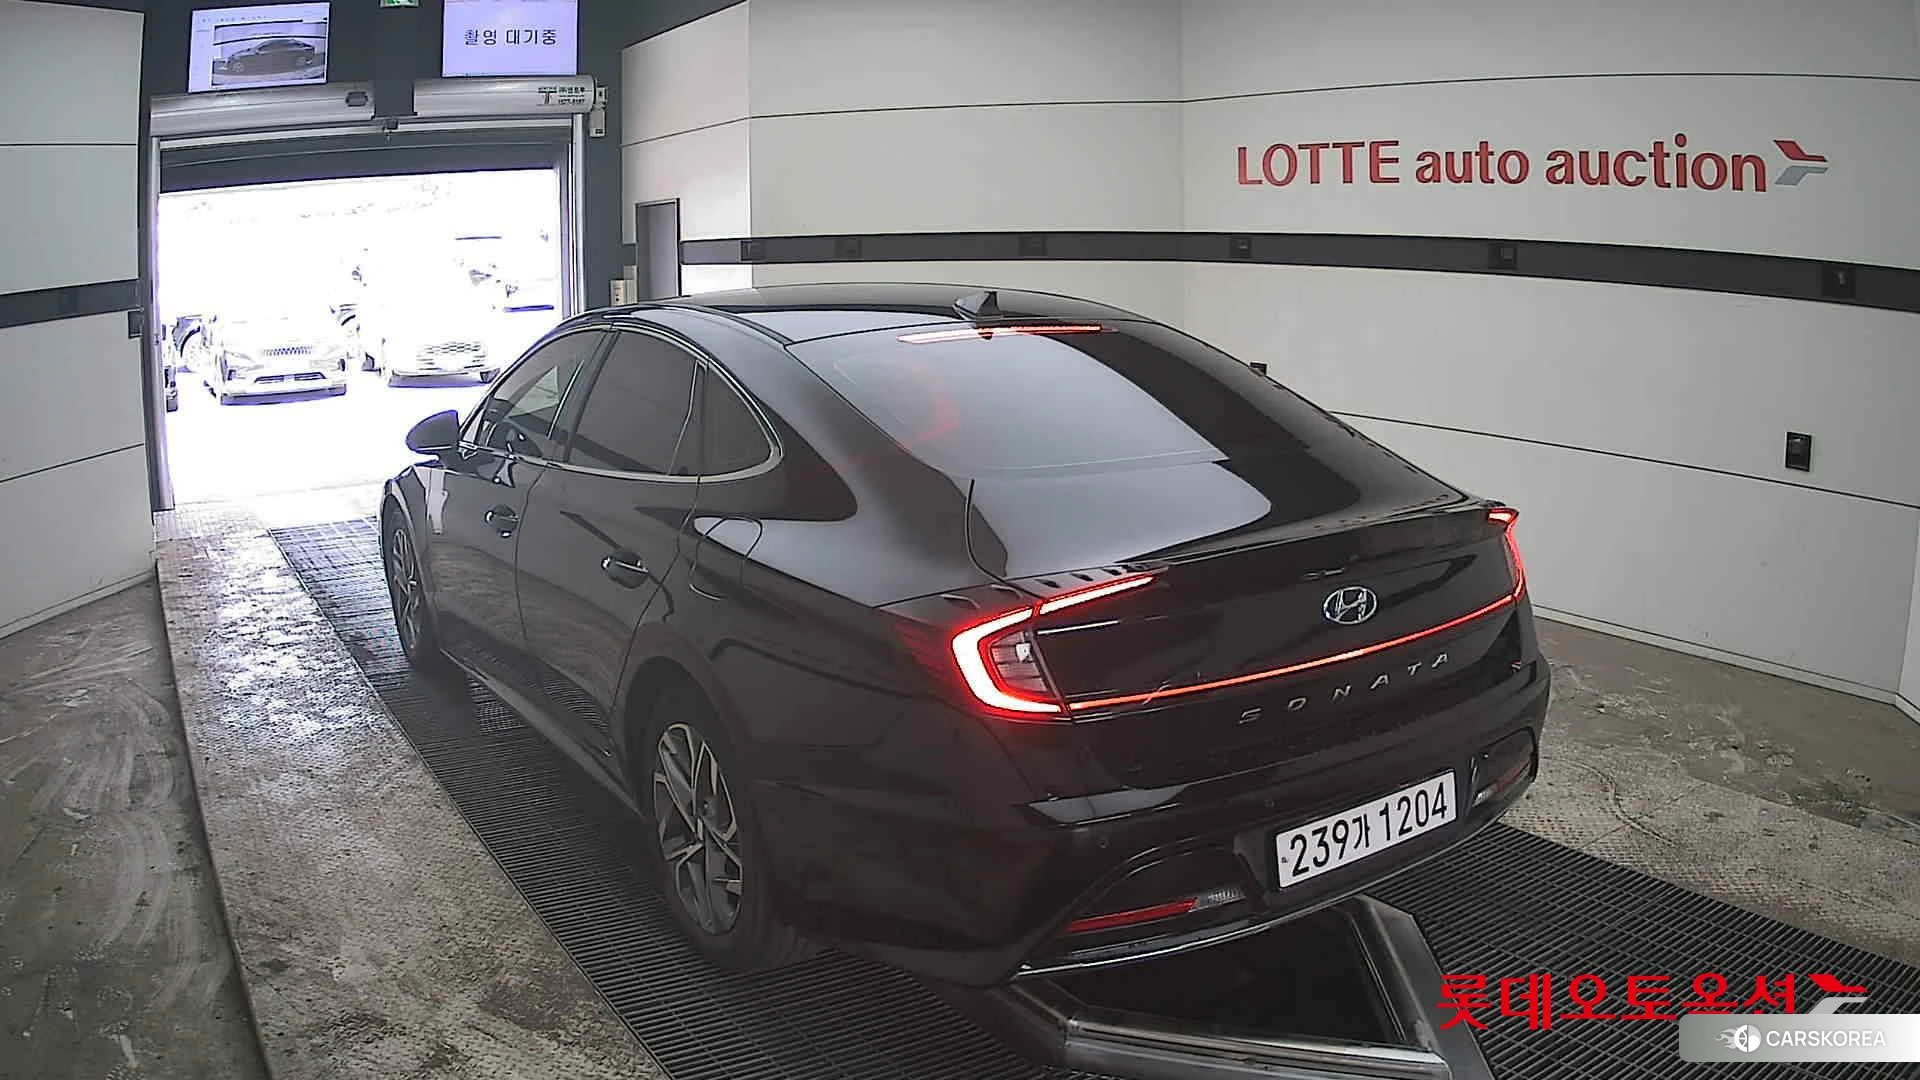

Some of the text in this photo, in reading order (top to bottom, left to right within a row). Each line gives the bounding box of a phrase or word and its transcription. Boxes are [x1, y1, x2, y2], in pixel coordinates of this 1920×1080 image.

[505, 28, 556, 46] 대기중
[1237, 132, 1767, 193] LOTTE auto auction
[1239, 652, 1448, 724] SONATA
[1289, 781, 1448, 877] 239가 1204
